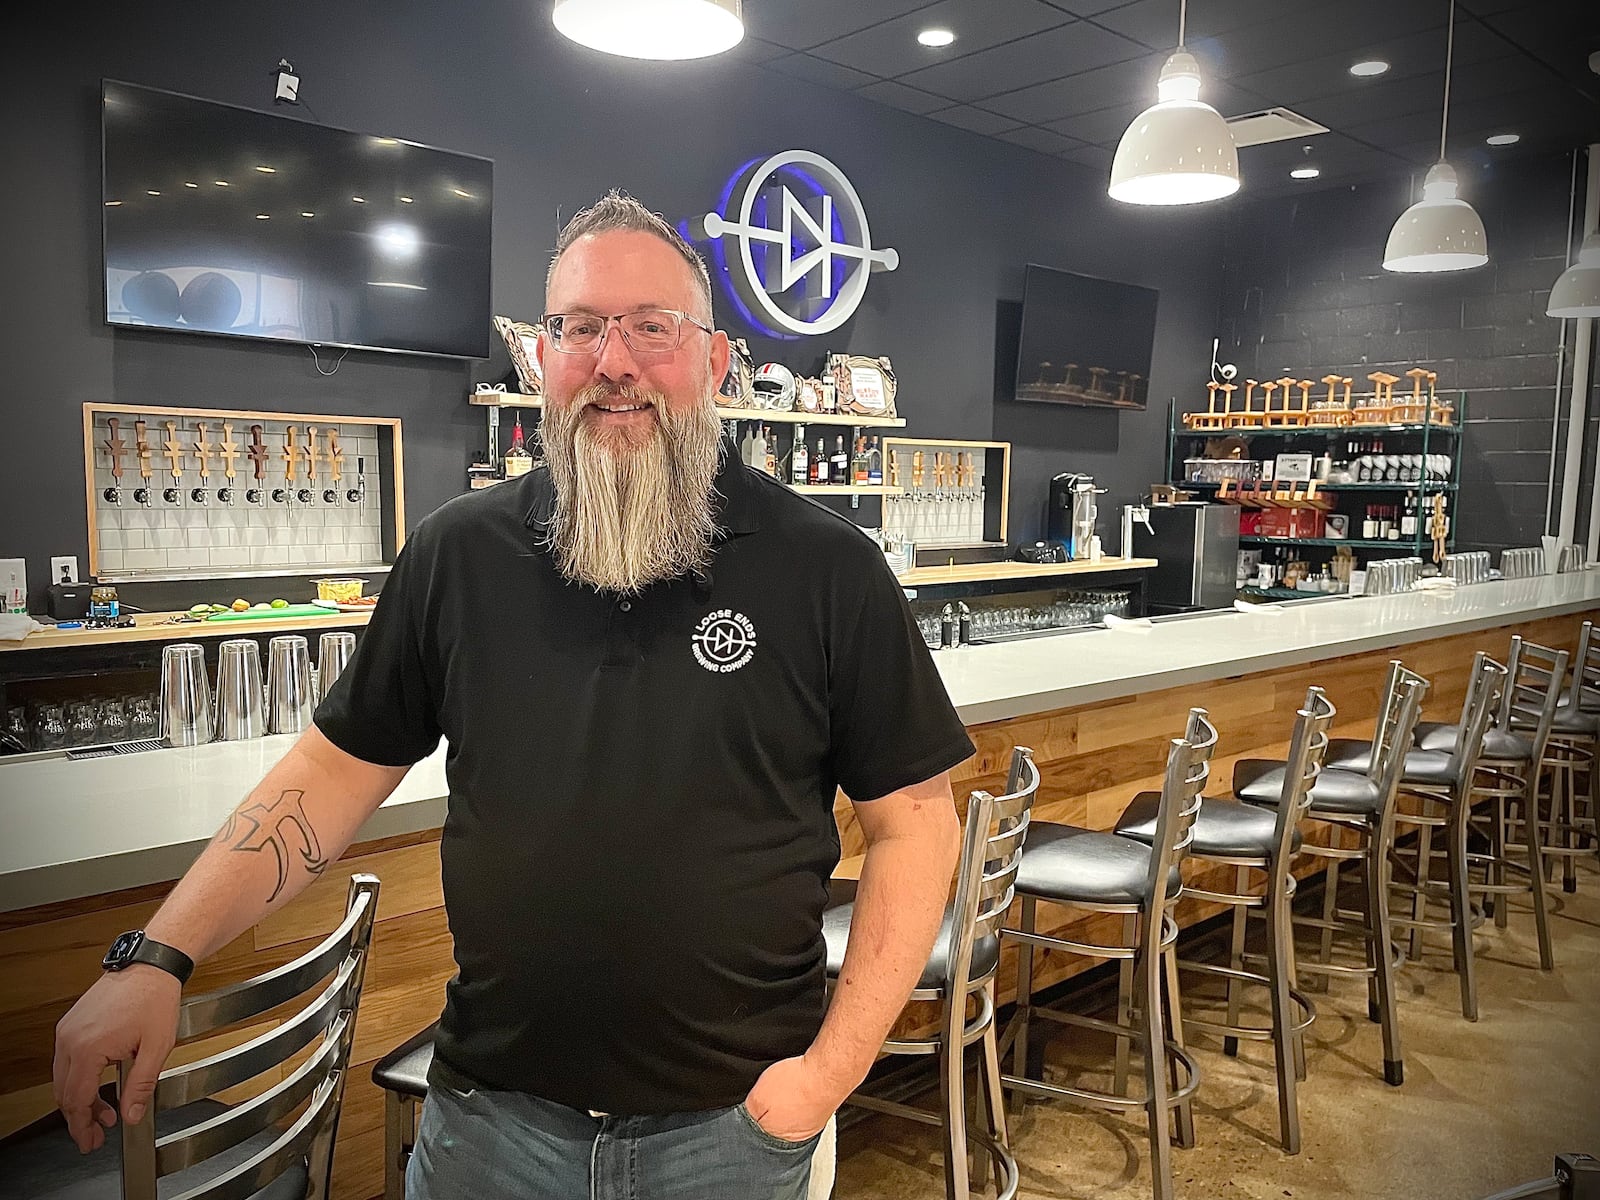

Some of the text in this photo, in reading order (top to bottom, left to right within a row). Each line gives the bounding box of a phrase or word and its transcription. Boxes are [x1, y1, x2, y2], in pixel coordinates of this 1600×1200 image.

[695, 609, 756, 639] LOOSE ENDS
[691, 642, 755, 673] BREWING COMPANY
